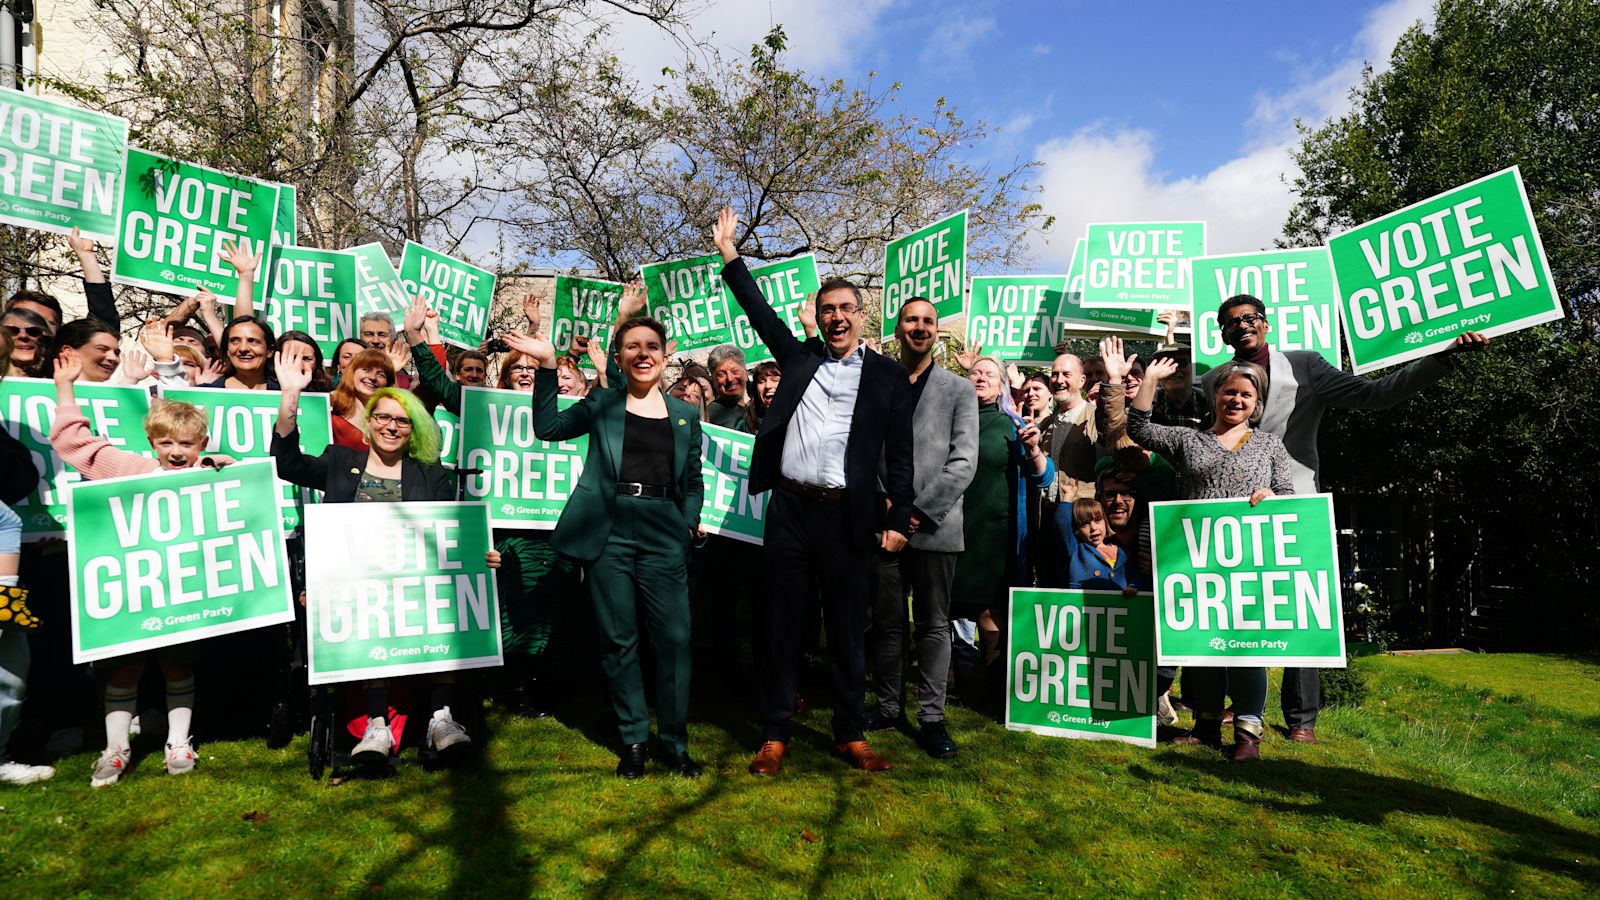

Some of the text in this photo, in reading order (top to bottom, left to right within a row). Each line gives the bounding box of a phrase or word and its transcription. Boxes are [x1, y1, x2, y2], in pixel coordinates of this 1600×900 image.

[12, 203, 71, 224] Green Party
[154, 169, 251, 232] VOTE
[898, 227, 951, 278] VOTE
[1107, 229, 1184, 256] VOTE
[1358, 195, 1493, 280] VOTE
[177, 274, 226, 291] Green Party
[273, 258, 335, 299] OTE
[421, 255, 479, 301] VOTE
[659, 262, 722, 302] VOTE
[756, 268, 805, 306] OTE
[886, 258, 961, 320] GREEN
[1151, 293, 1170, 301] Party
[1214, 262, 1310, 304] VOTE
[1348, 234, 1540, 340] GREEN
[266, 297, 353, 342] REEN
[572, 287, 620, 322] VOT
[654, 296, 725, 339] GREE
[987, 285, 1049, 313] VOTE
[1120, 314, 1137, 322] Party
[971, 315, 1060, 347] GREEN
[1424, 312, 1492, 338] Green Party
[195, 405, 305, 453] VOT
[108, 478, 246, 548] VOTE
[517, 506, 562, 516] Green Party
[708, 514, 728, 524] Party
[1181, 513, 1301, 569] VOTE
[82, 529, 279, 620] GREEN
[164, 606, 234, 627] Green Party
[318, 574, 491, 644] GREEN
[1163, 570, 1332, 632] GREEN
[1034, 603, 1128, 655] VOTE
[1228, 638, 1288, 652] Green Party
[390, 644, 451, 658] Green Party
[1014, 652, 1148, 714] GREEN
[1062, 714, 1111, 729] Green Party
